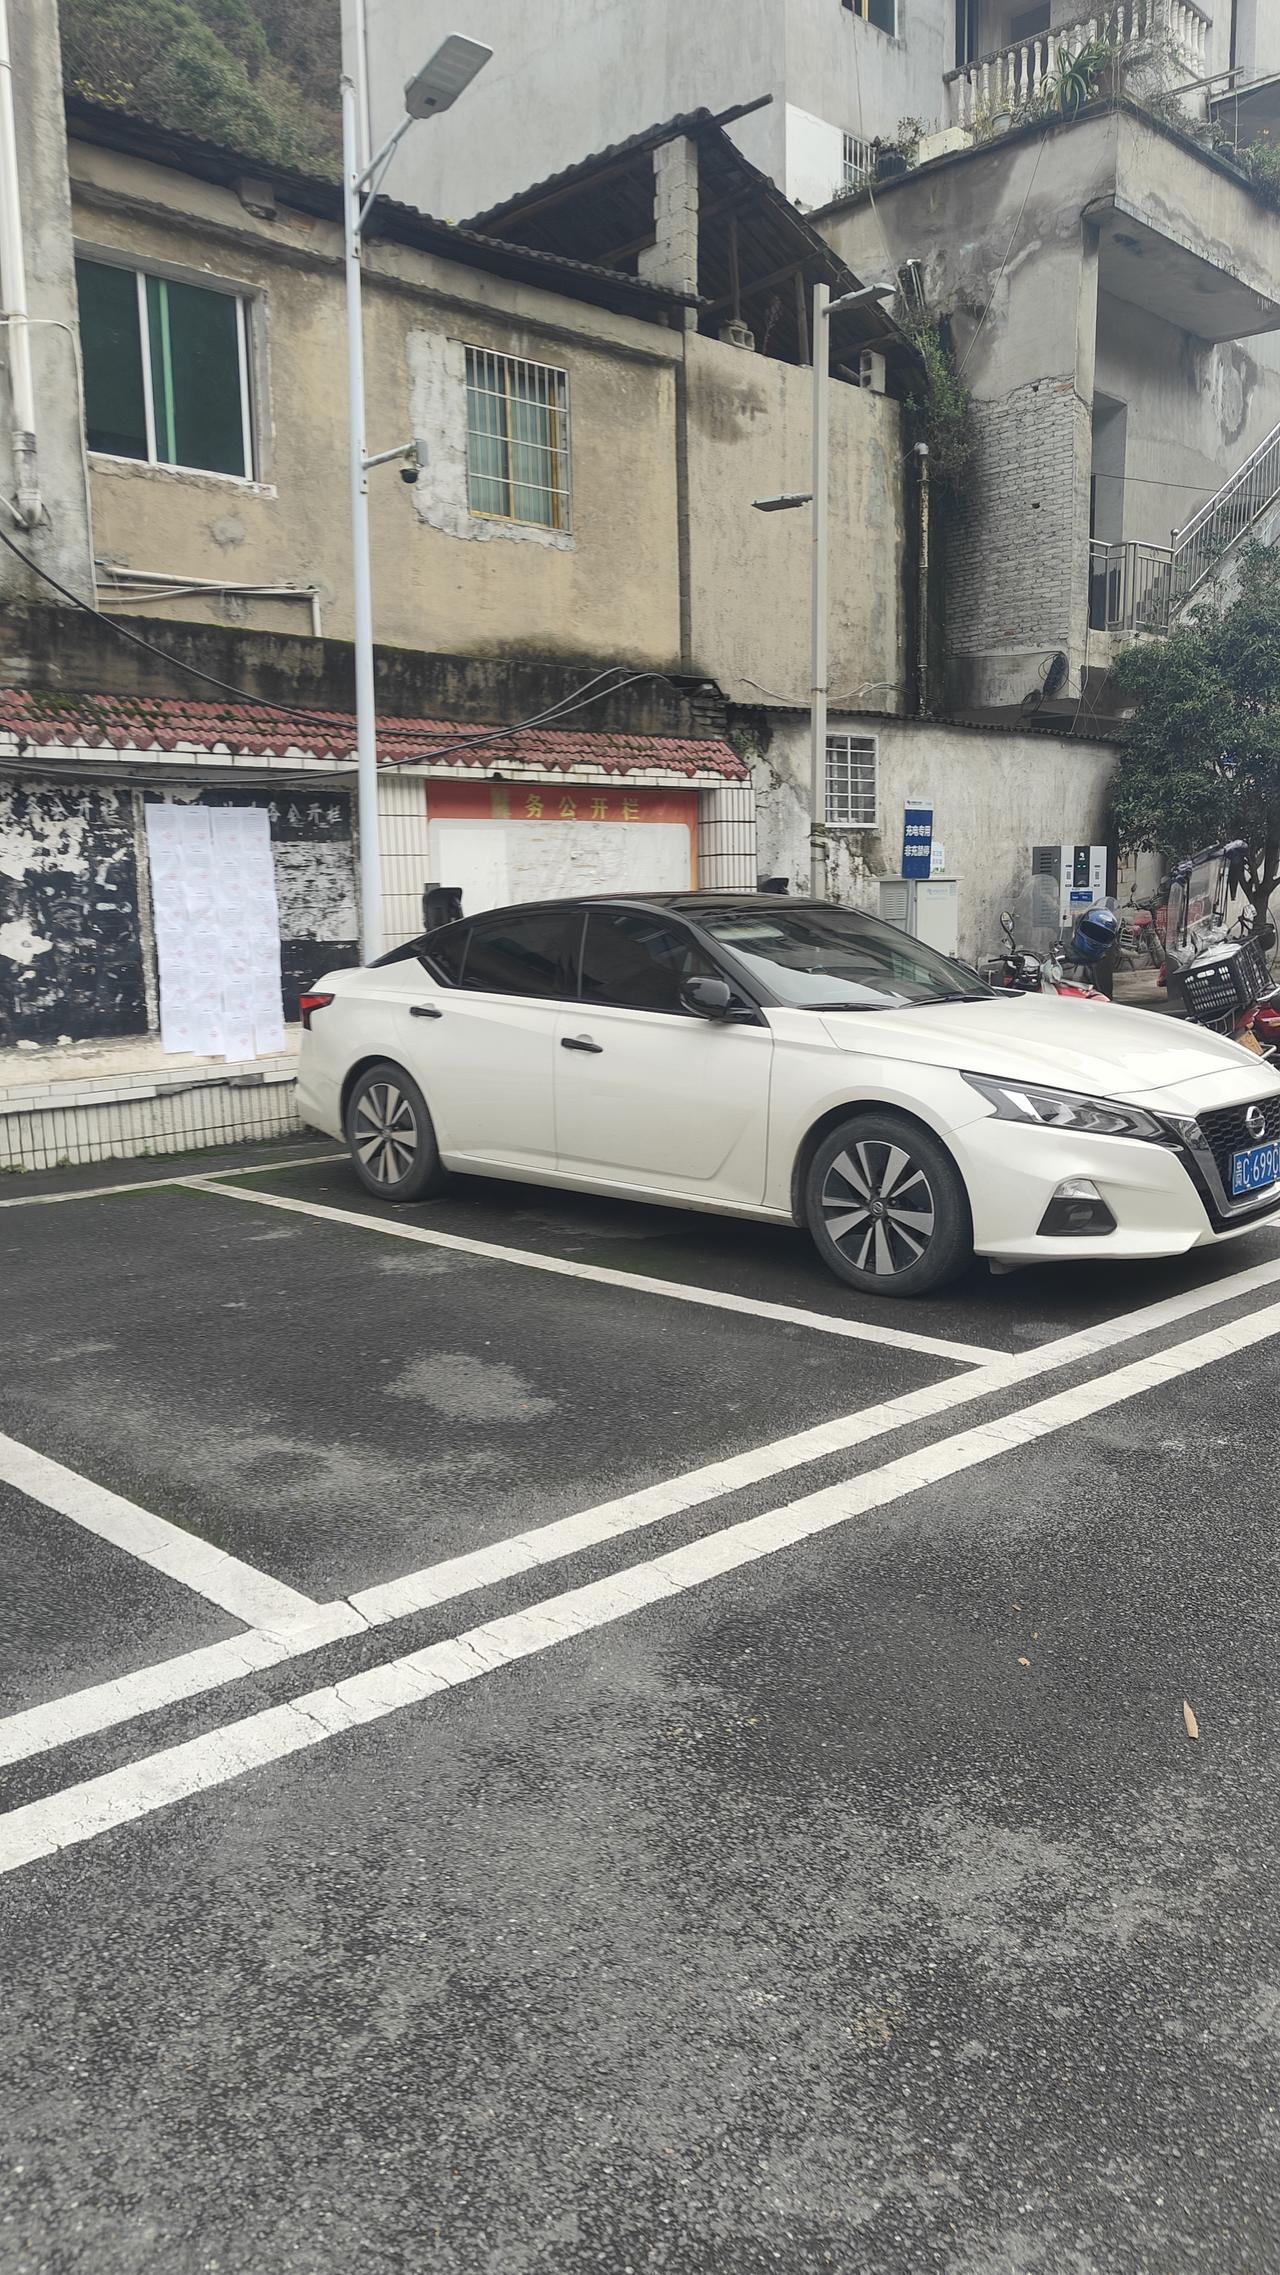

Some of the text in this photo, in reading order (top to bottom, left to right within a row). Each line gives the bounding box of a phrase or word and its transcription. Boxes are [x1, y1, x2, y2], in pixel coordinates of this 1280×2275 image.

[493, 790, 642, 820] 务公开栏
[905, 825, 932, 837] 充电专用
[1236, 1149, 1280, 1187] 贵C·699C
